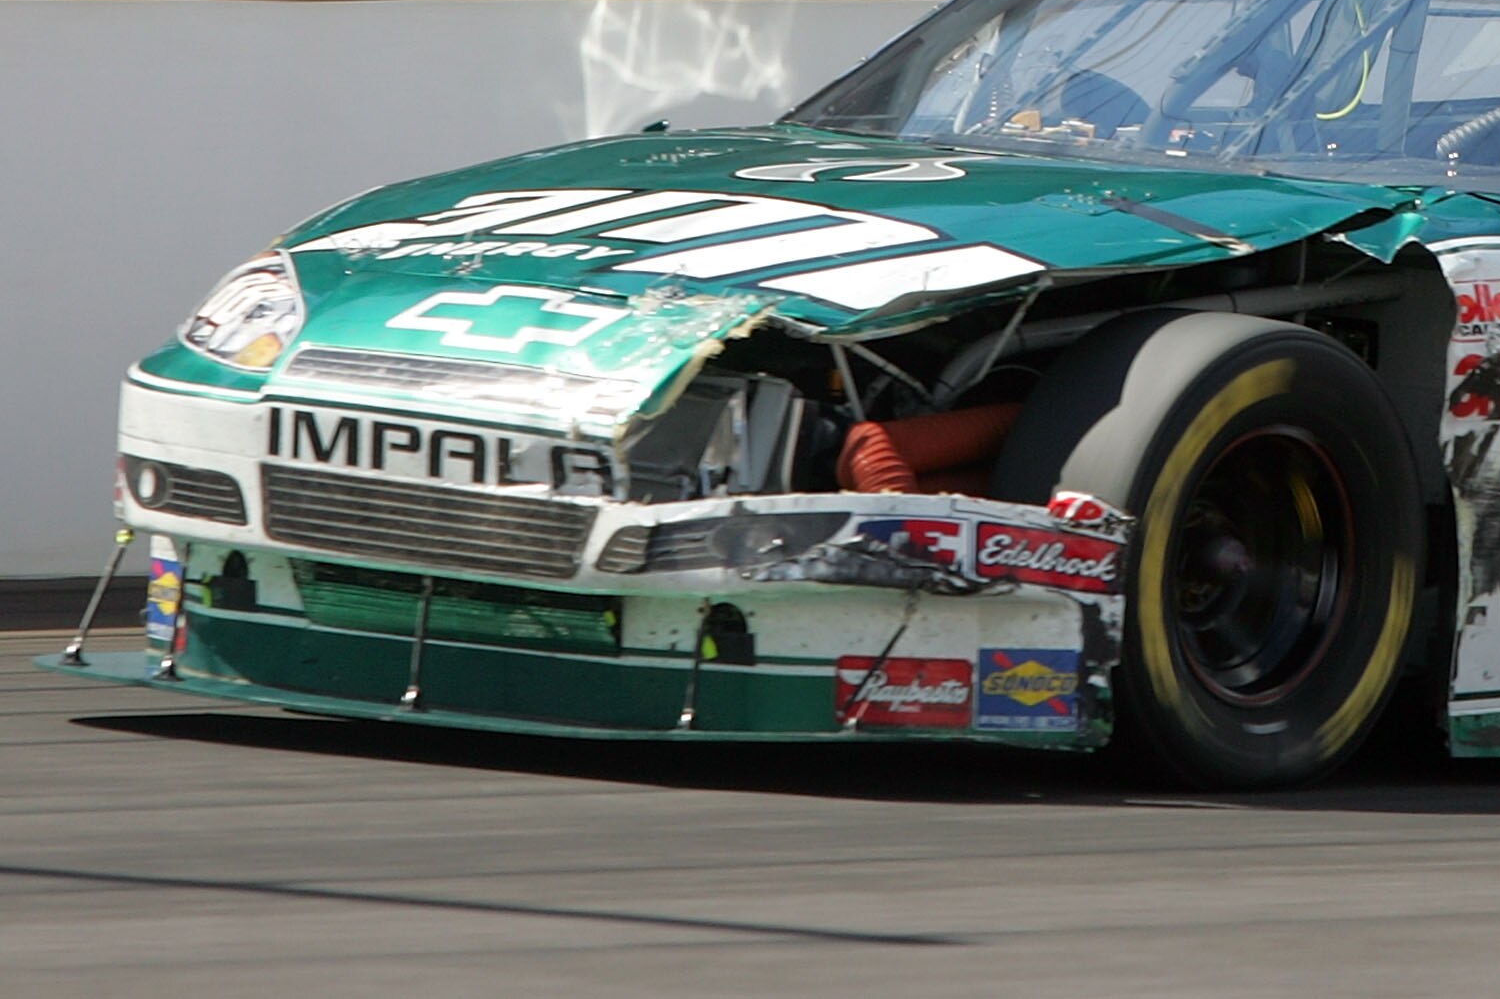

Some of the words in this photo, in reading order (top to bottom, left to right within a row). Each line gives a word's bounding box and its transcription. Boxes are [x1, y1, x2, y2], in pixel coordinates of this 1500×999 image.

[268, 406, 615, 497] IMPALA
[978, 533, 1117, 581] Edelbrock
[985, 674, 1076, 693] SUNOCO
